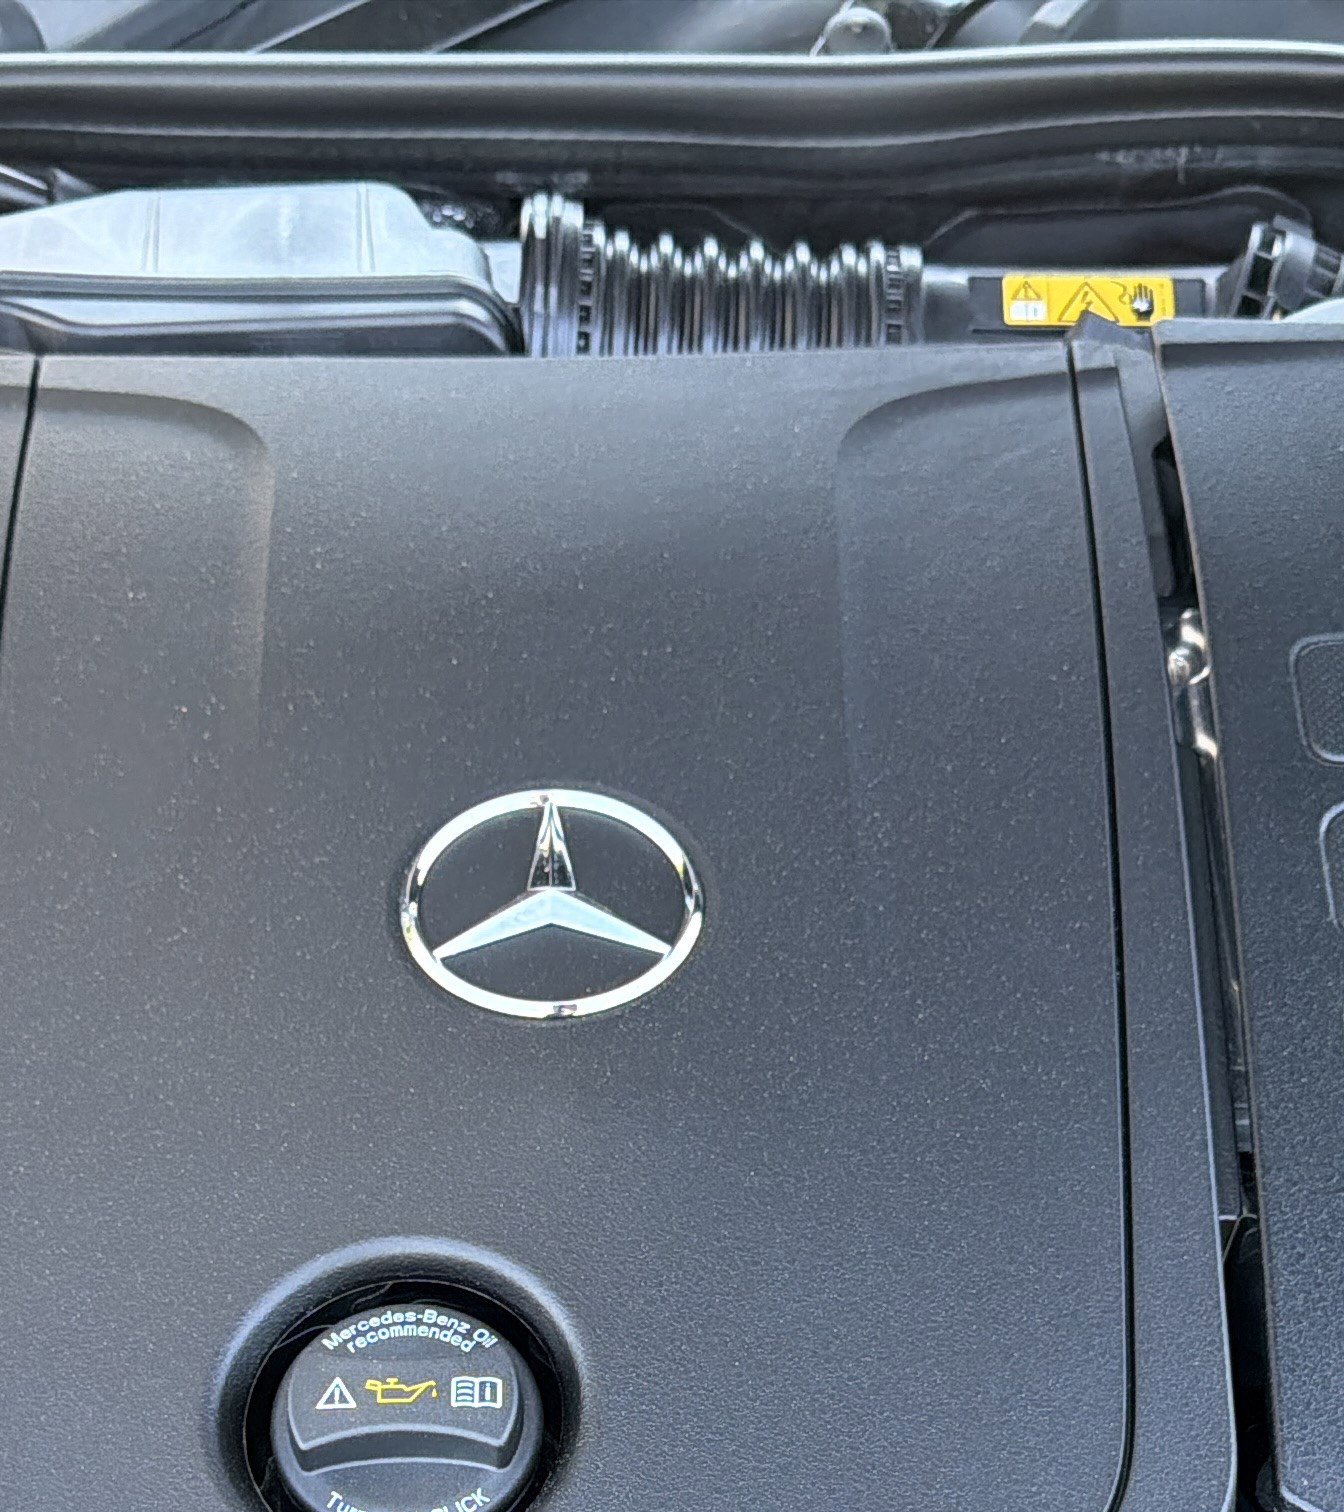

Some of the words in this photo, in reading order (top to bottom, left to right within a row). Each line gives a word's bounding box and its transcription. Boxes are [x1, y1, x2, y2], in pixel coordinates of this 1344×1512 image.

[321, 1309, 471, 1351] Mercedes-Benz
[473, 1327, 498, 1350] Oil
[346, 1323, 477, 1354] recommended
